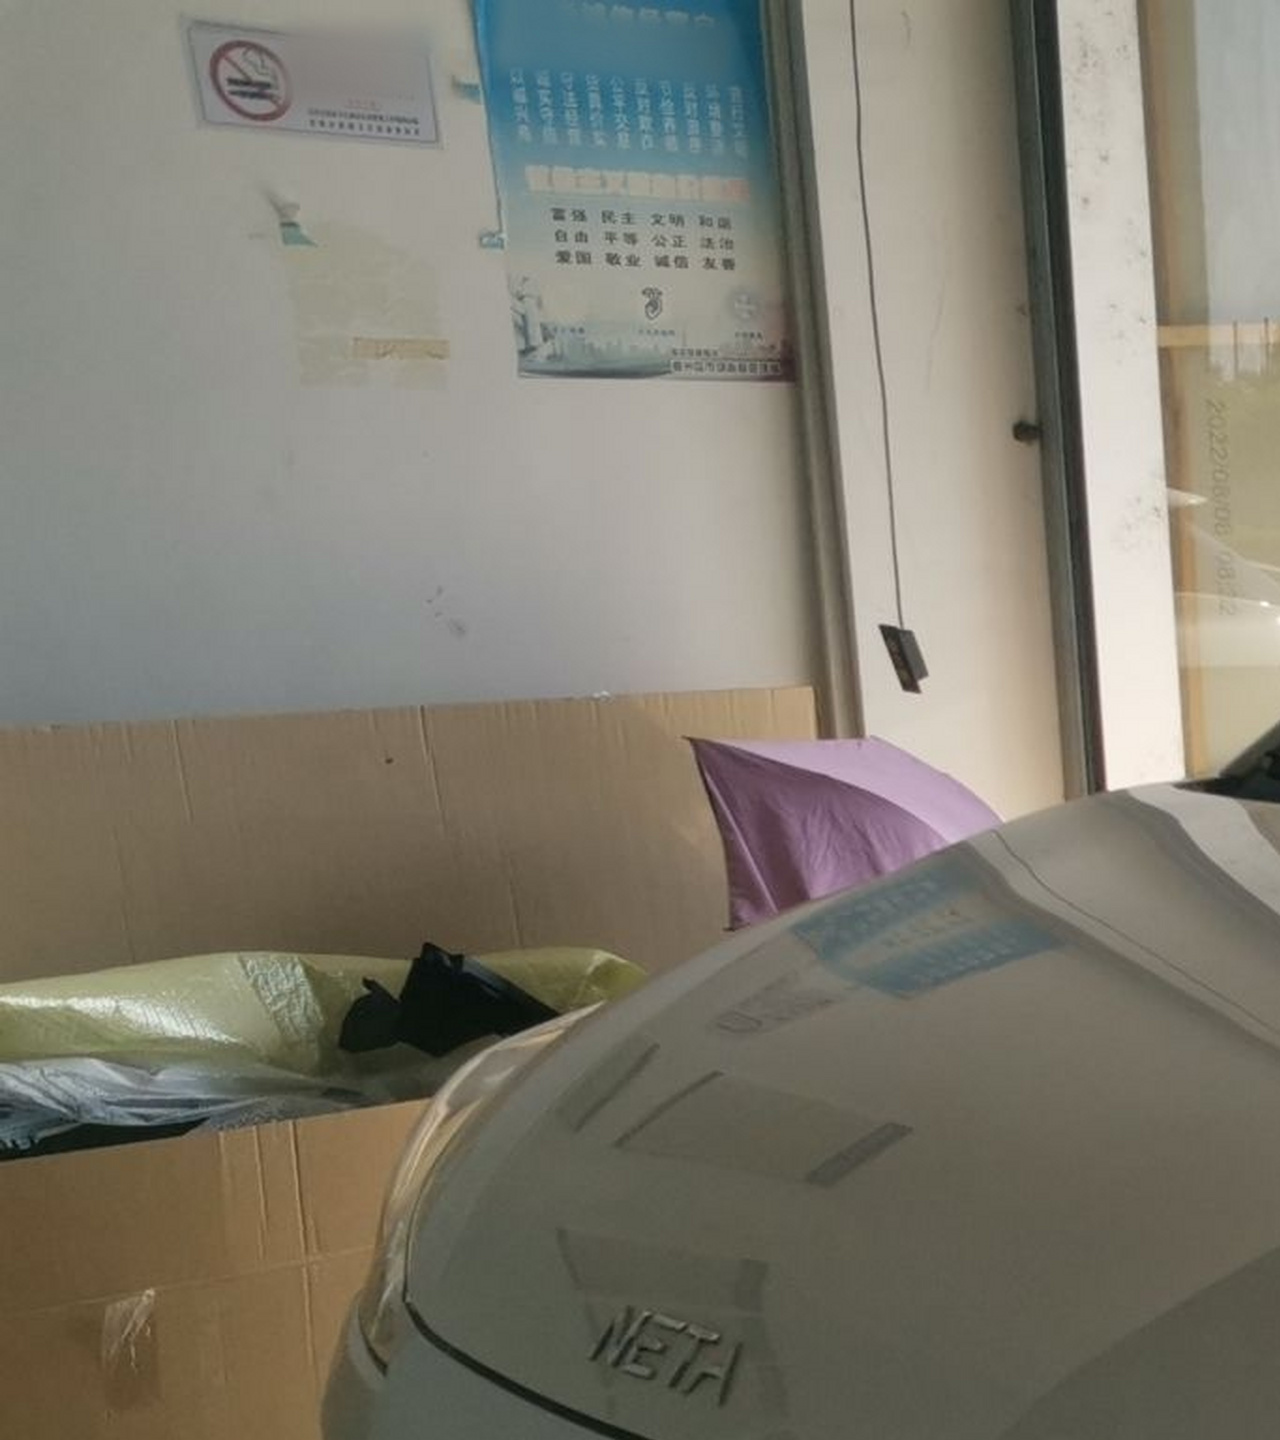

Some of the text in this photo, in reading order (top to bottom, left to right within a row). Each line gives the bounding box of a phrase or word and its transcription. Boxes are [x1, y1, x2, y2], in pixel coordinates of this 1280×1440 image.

[551, 208, 587, 222] 富强
[601, 210, 634, 225] 民主
[651, 213, 685, 227] 文明
[554, 229, 734, 250] 自由 平等 公正 法治
[556, 250, 736, 271] 爱国 敬业 诚信 友善
[589, 1305, 743, 1408] NETA
